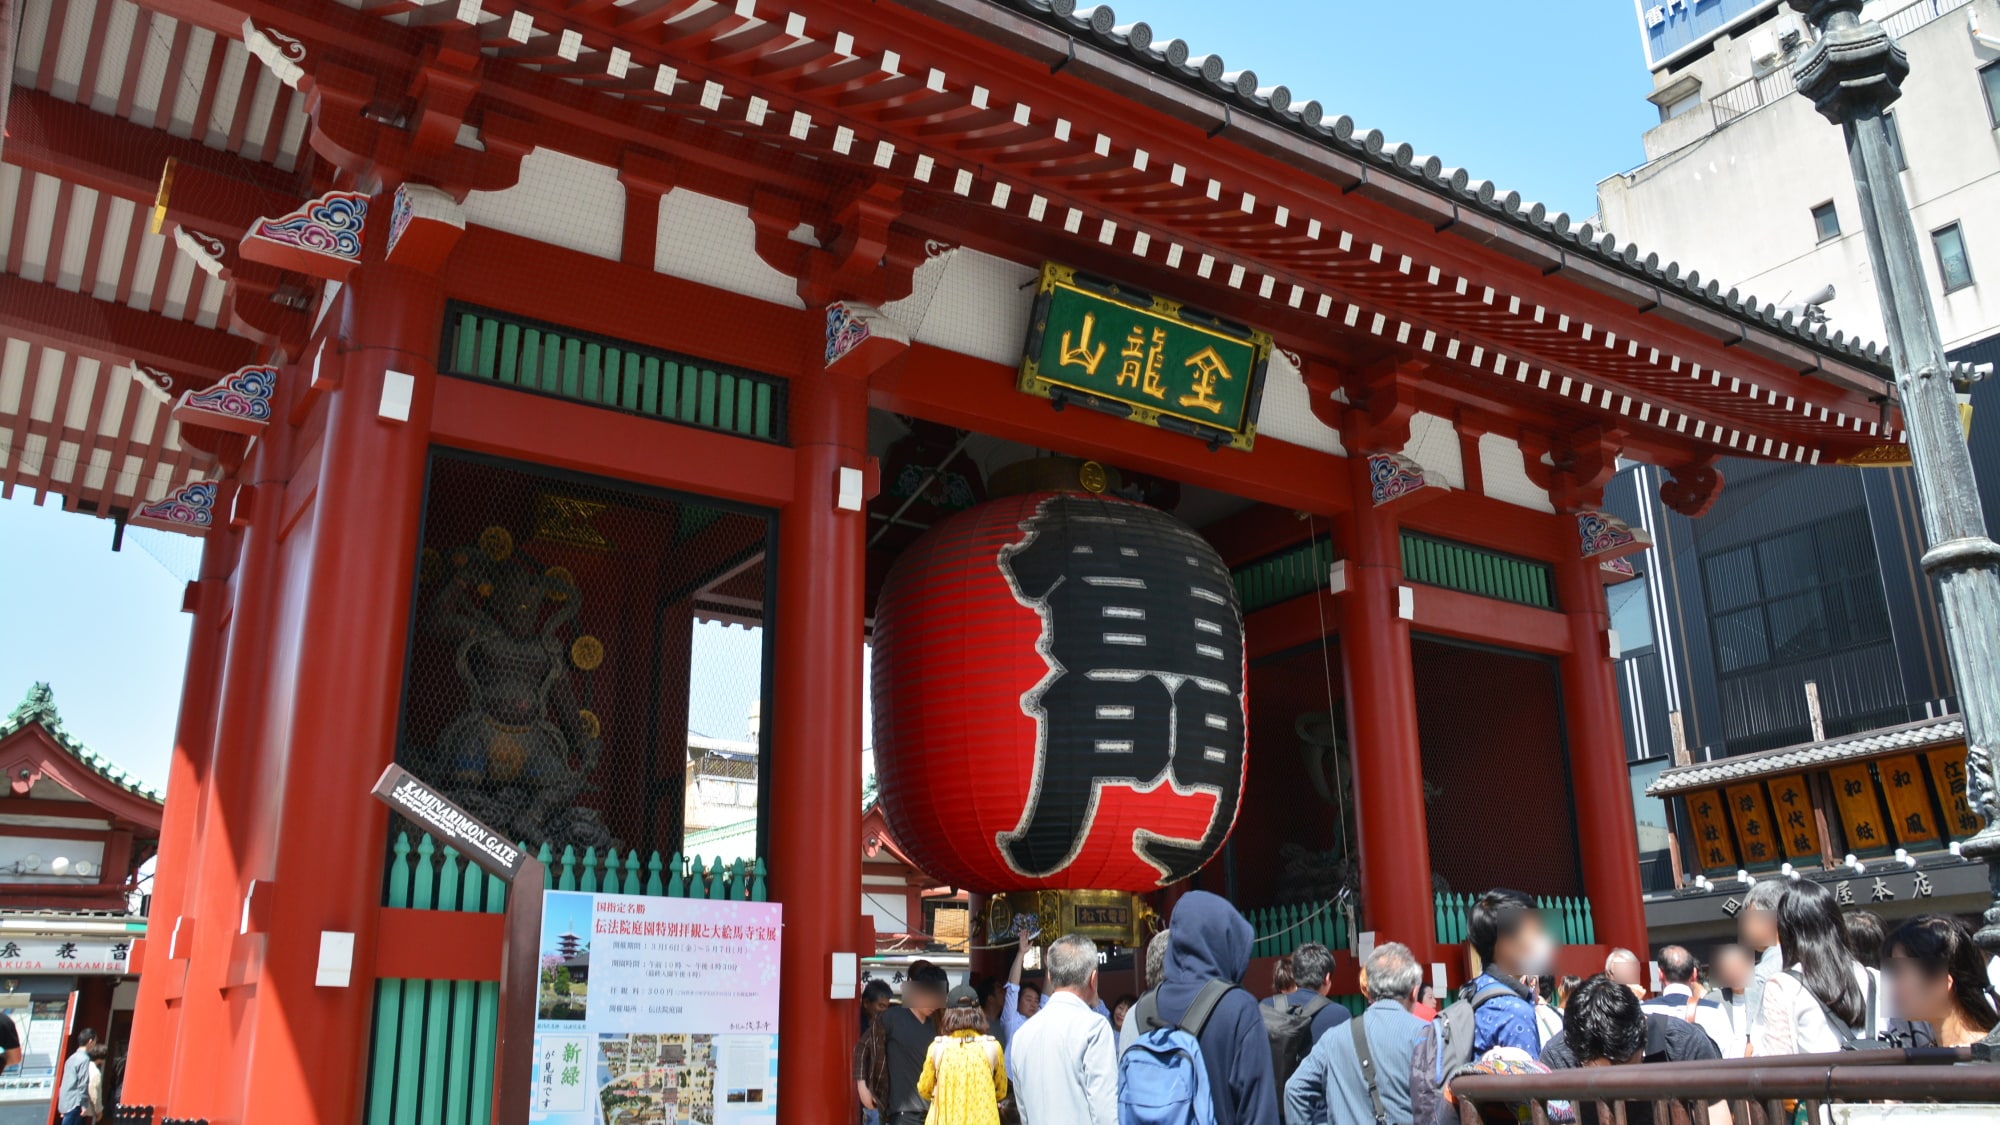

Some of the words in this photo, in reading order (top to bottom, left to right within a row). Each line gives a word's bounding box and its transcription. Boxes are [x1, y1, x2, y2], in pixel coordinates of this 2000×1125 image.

[1645, 0, 1701, 28] 雷門
[997, 495, 1249, 886] 雷門
[402, 781, 488, 842] KAMINARIMON
[486, 837, 518, 863] GATE
[1782, 788, 1811, 851] 千代紙
[1844, 780, 1874, 839] 和紙
[1944, 761, 1978, 830] 江戸小物
[595, 918, 777, 941] 伝法院庭園特別拝観と大絵馬寺宝展
[597, 901, 645, 914] 国指定名勝
[0, 961, 42, 969] KUSA
[58, 962, 122, 970] NAKAMISE
[542, 1050, 555, 1109] が見頃です
[560, 1042, 582, 1087] 新緑
